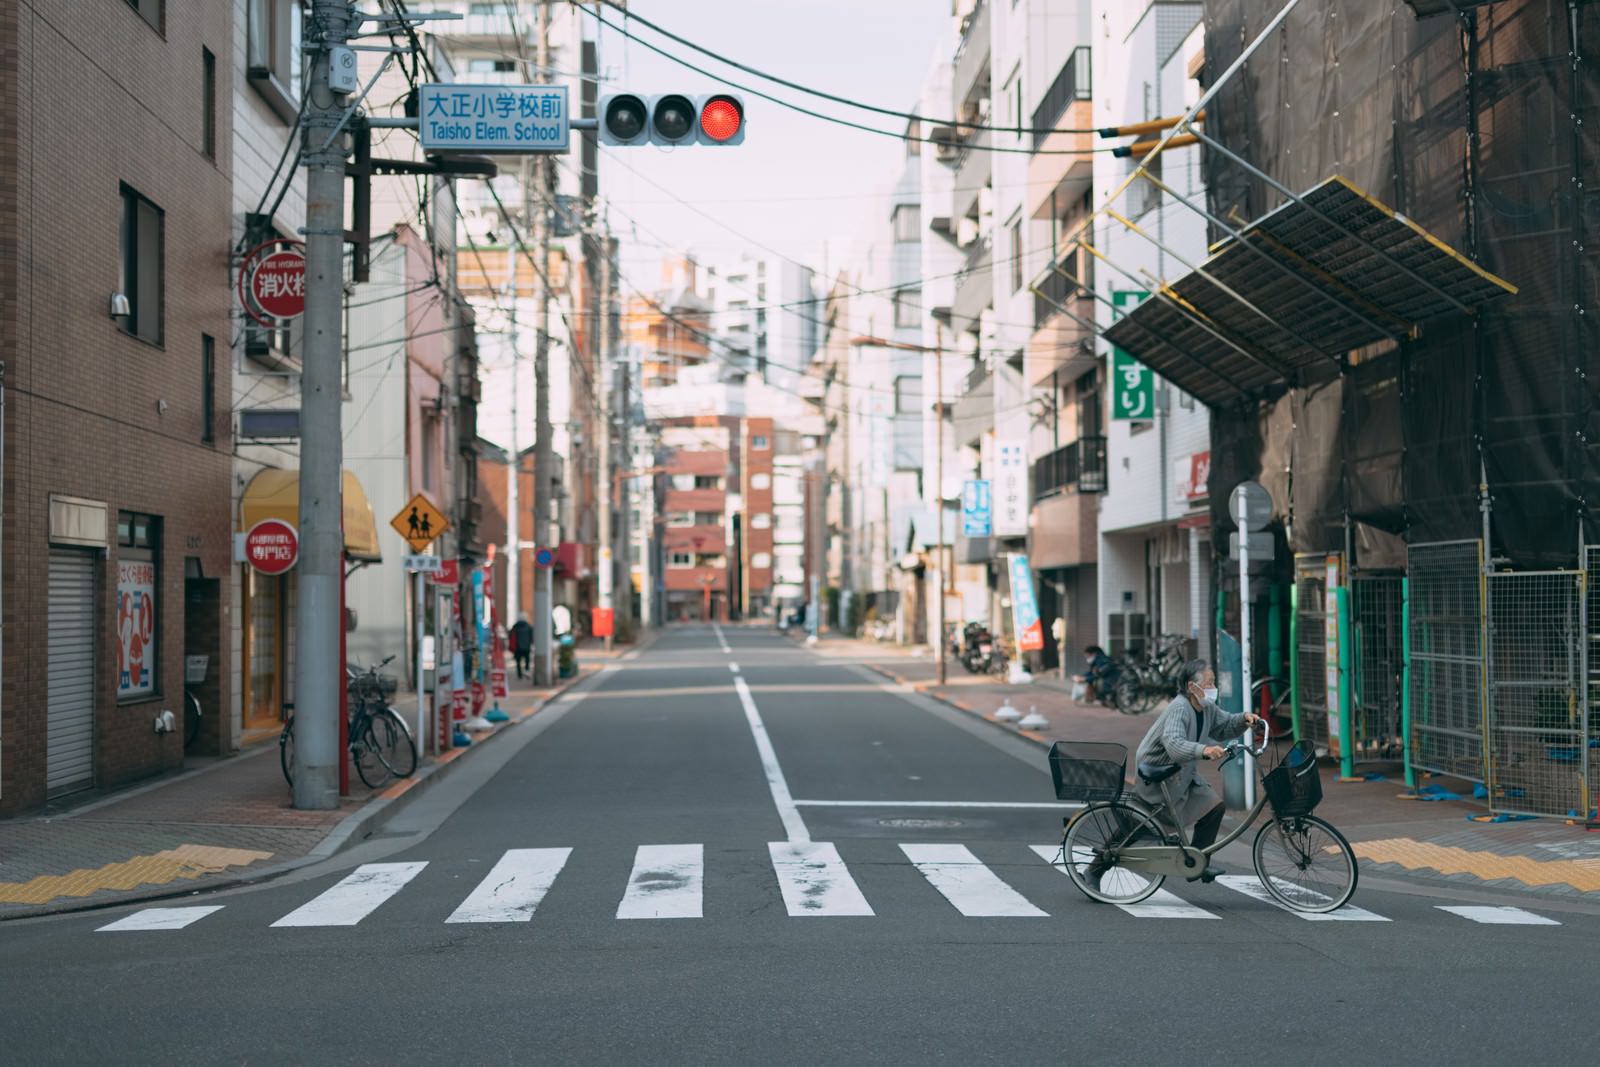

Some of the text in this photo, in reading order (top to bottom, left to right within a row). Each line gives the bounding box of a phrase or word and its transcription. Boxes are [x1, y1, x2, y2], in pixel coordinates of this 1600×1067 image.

[427, 92, 561, 119] 大正小学校前
[429, 121, 560, 141] Taisho Elem. School
[278, 260, 304, 269] HYDRAN
[252, 545, 291, 560] 専門店
